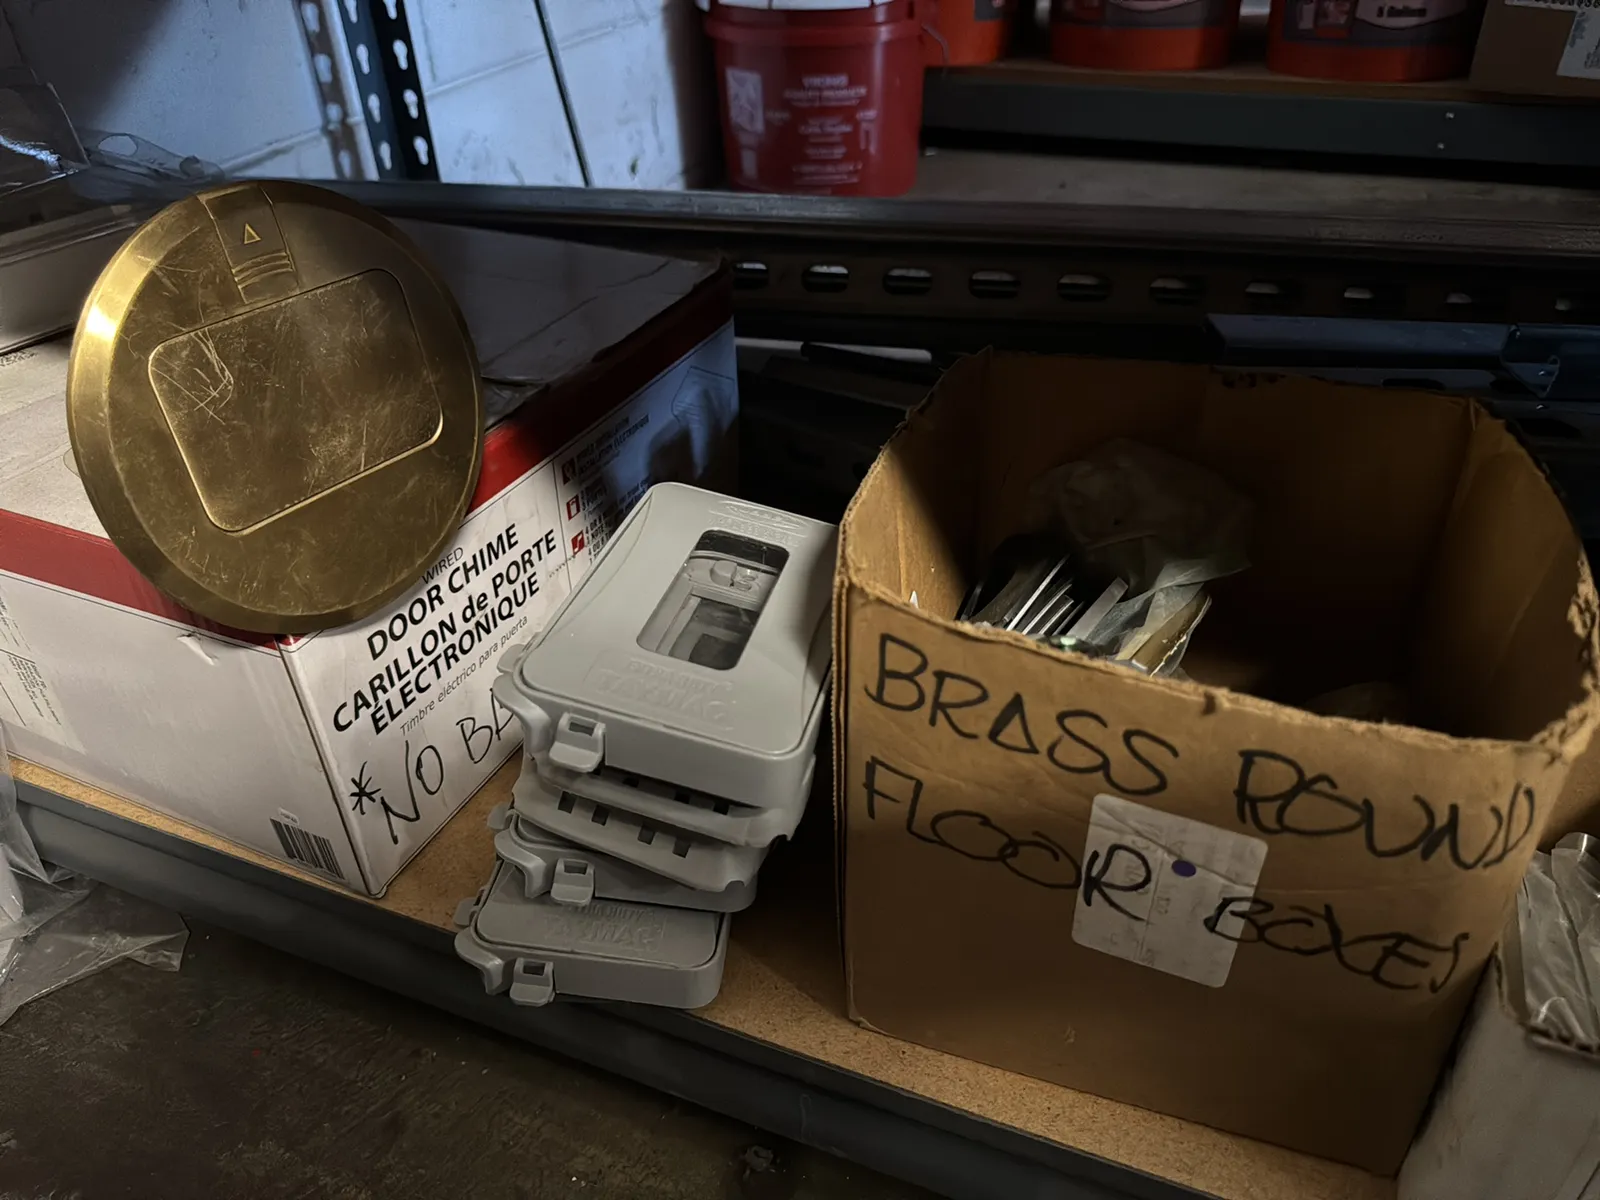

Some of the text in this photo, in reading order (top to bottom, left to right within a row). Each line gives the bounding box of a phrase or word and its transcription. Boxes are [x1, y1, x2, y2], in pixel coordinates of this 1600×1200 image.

[333, 529, 557, 732] CARILLON de PORTE
[366, 523, 519, 660] DOOR CHIME
[422, 547, 464, 584] WIRED
[370, 571, 540, 735] ÉLECTRONIQUE
[400, 614, 529, 737] Timbre eléctrico para puerta
[863, 633, 1535, 870] BRASS ROUND
[862, 756, 1153, 923] FLOOR
[1203, 896, 1470, 993] BOXES
